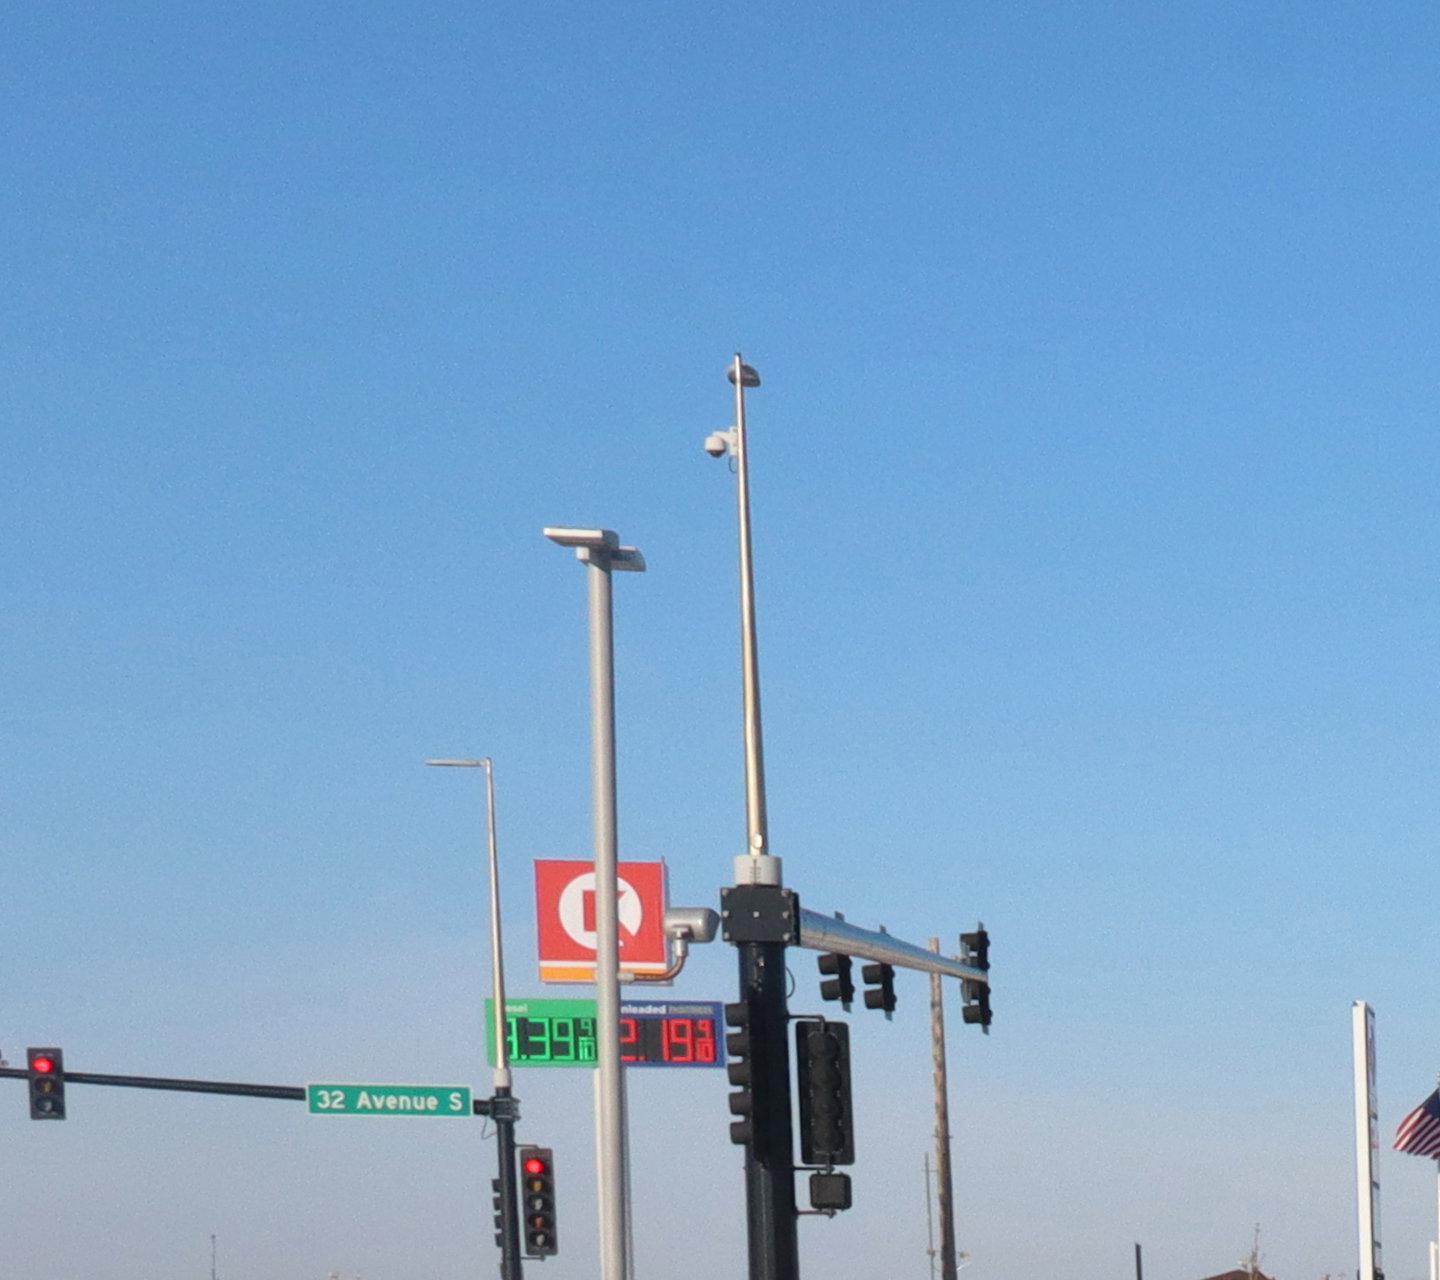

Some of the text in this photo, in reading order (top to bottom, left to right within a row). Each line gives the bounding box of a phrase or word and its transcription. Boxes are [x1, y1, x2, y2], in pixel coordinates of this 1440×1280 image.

[317, 1090, 463, 1112] 32 Avenue S
